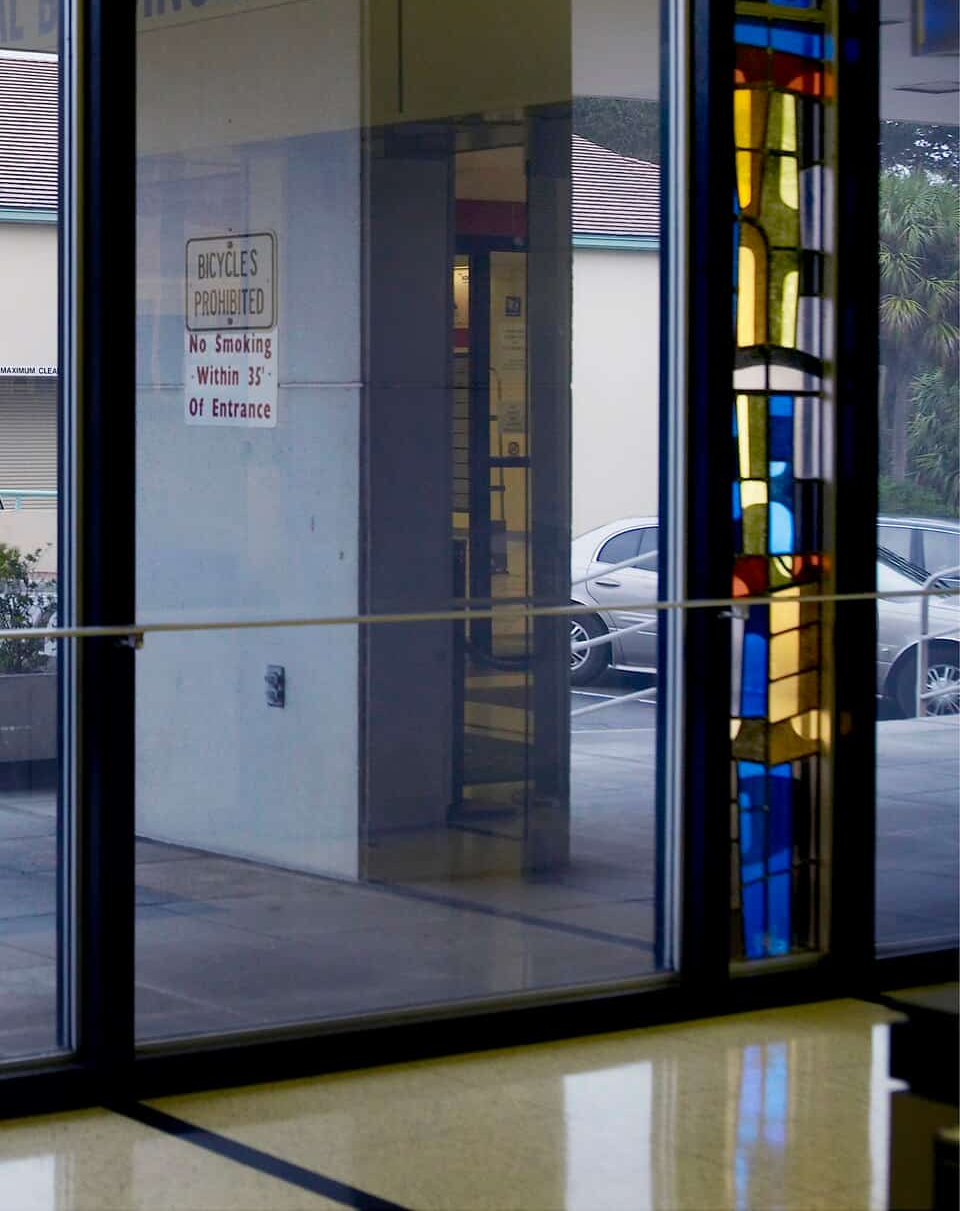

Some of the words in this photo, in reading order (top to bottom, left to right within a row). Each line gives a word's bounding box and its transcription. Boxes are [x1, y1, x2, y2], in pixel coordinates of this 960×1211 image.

[198, 248, 259, 280] BICYCLES
[194, 288, 264, 317] PROHIBITED
[189, 334, 207, 354] No
[215, 332, 272, 359] Smoking
[0, 366, 36, 374] MAXIMUM
[196, 365, 239, 386] Within
[247, 366, 265, 386] 35'
[189, 397, 204, 417] Of
[212, 397, 271, 419] Entrance
